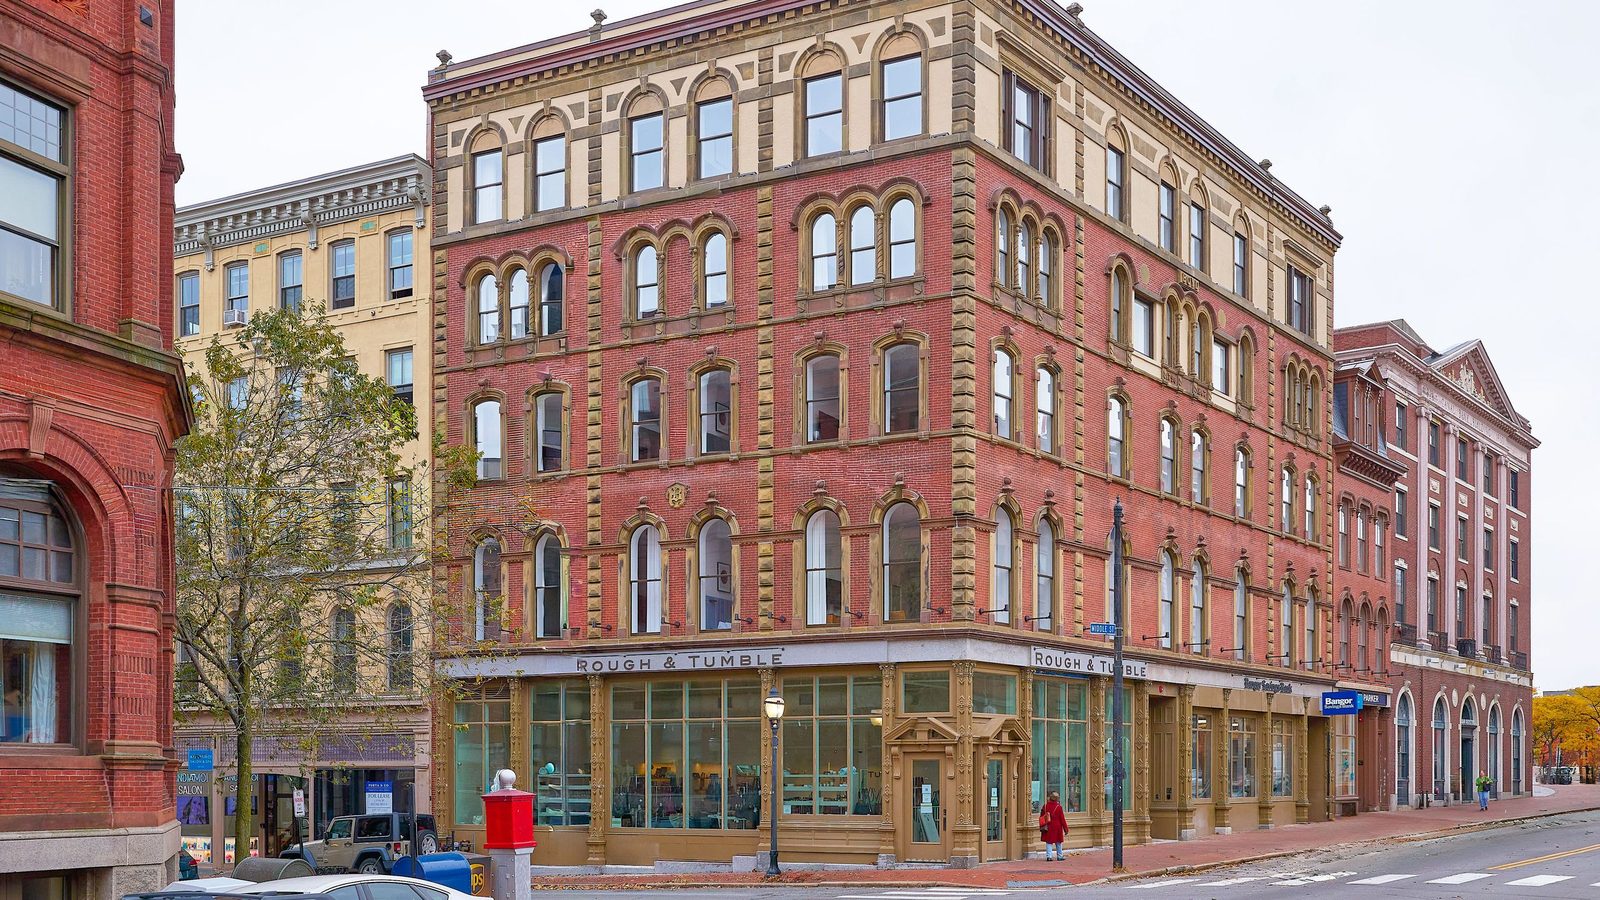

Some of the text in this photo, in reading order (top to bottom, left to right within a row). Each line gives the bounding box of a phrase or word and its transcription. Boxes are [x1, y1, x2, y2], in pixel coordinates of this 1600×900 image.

[1091, 624, 1115, 633] MIDDLE ST
[577, 653, 783, 672] ROUGH & TUMBLE
[1035, 652, 1147, 677] ROUGH & TUBLE
[1325, 697, 1353, 706] Bangor
[178, 785, 203, 795] SALON
[471, 873, 484, 891] ps
